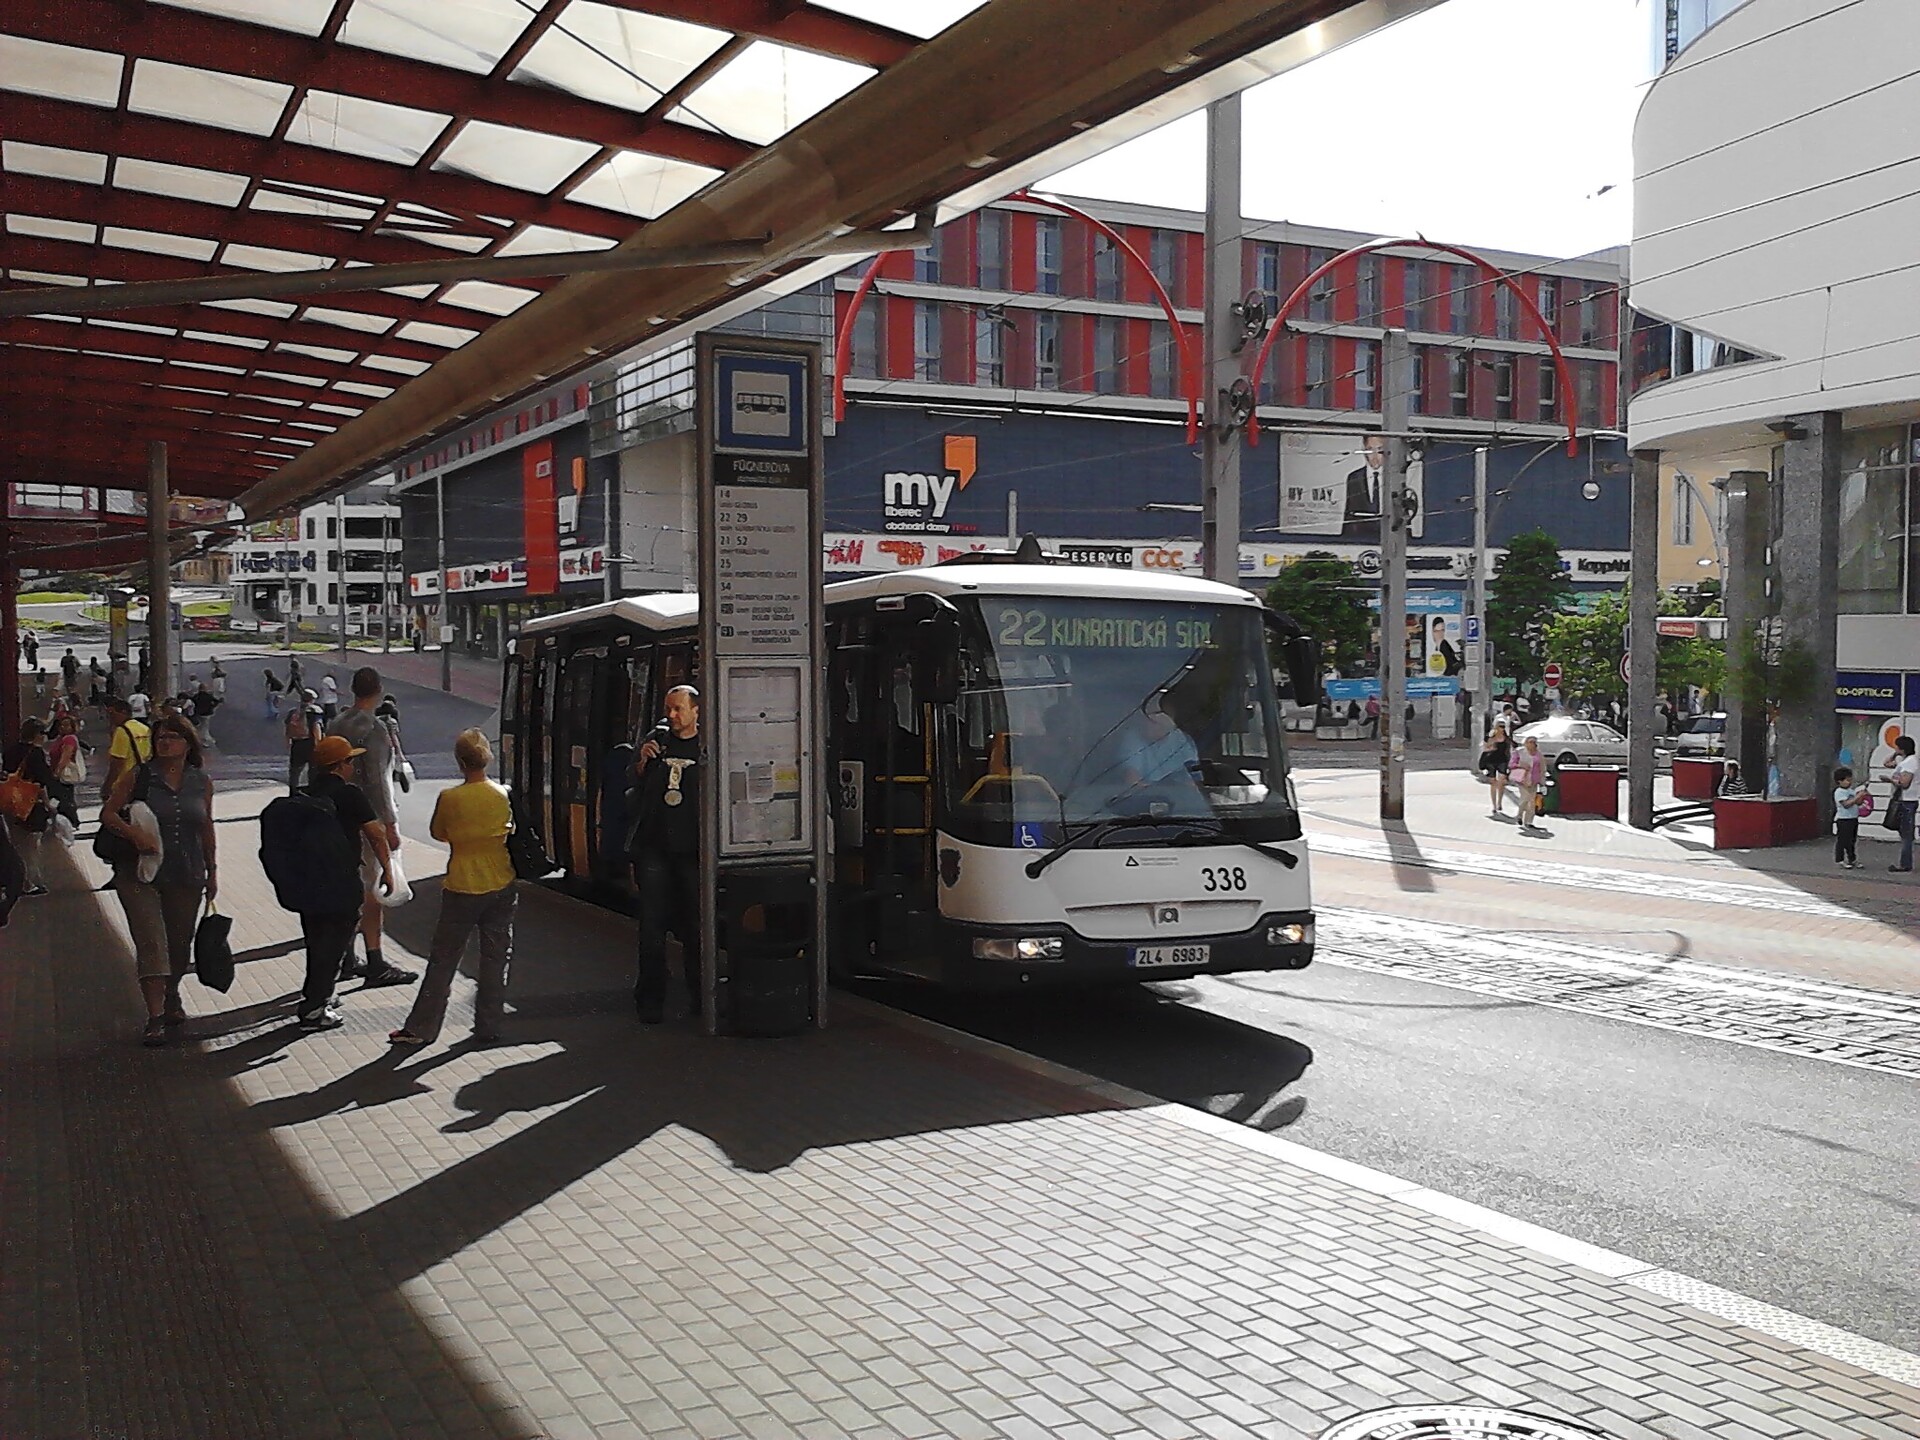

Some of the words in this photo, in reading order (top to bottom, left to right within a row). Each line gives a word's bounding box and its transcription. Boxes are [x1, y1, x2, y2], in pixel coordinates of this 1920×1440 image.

[720, 490, 731, 498] 14
[884, 473, 955, 518] my
[885, 506, 922, 517] liberec
[720, 513, 731, 522] 22
[736, 513, 748, 523] 29
[720, 536, 731, 546] 21
[736, 536, 748, 546] 52
[720, 559, 732, 569] 25
[1141, 549, 1183, 568] CCC
[720, 582, 732, 591] 34
[1000, 608, 1046, 646] 22
[1201, 867, 1247, 891] 338
[1138, 950, 1163, 965] 2L4
[1172, 947, 1205, 963] 6983
